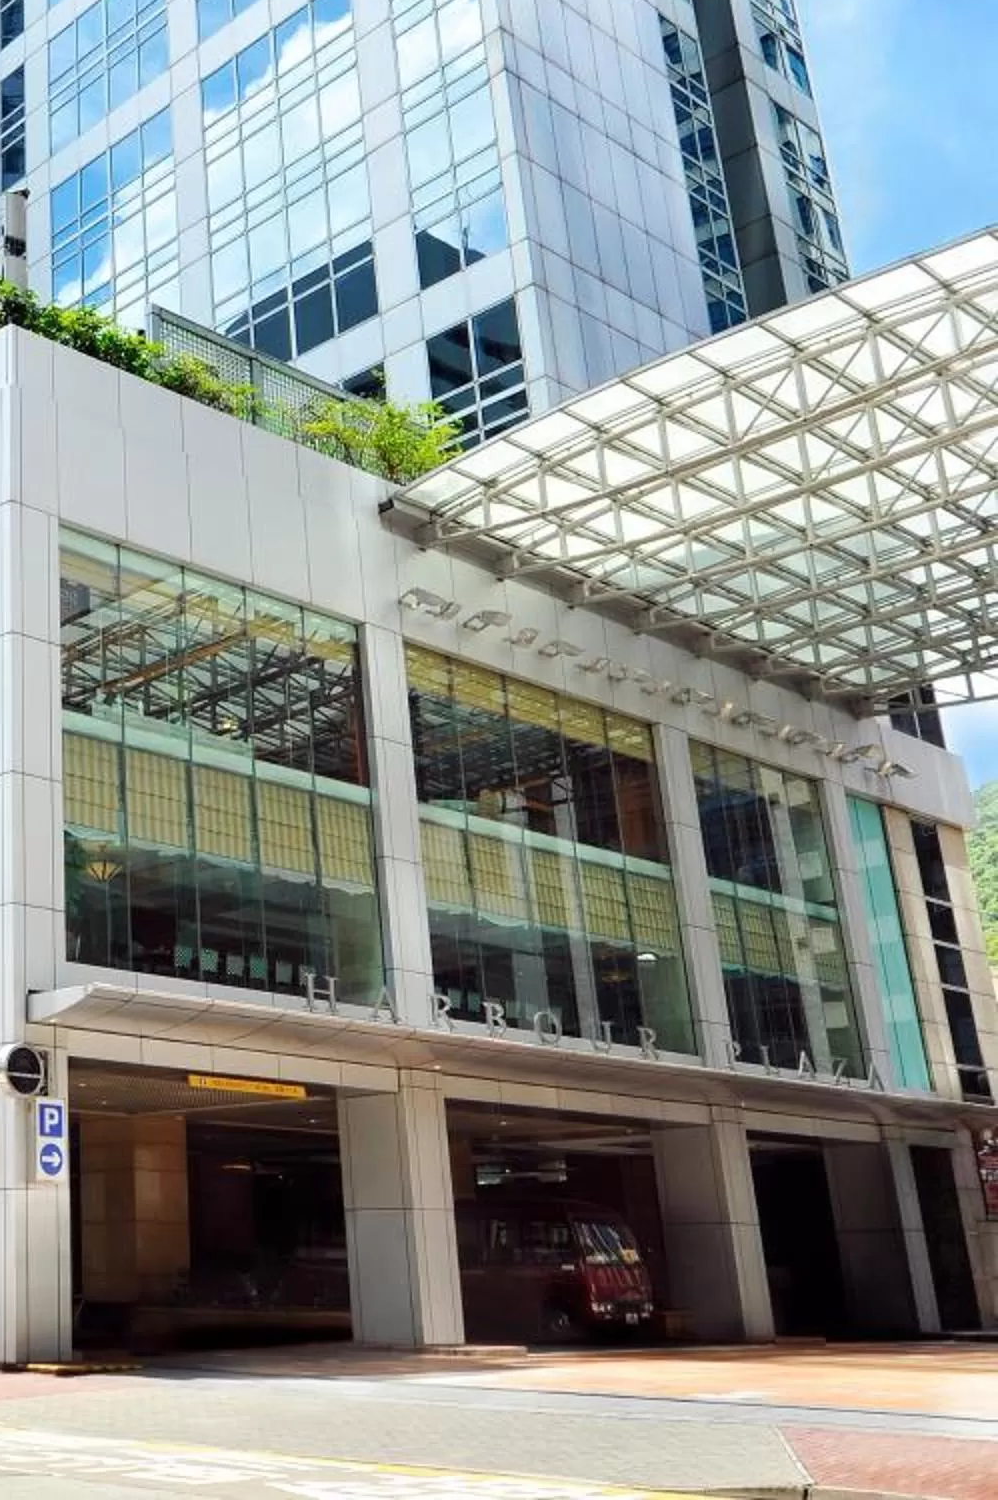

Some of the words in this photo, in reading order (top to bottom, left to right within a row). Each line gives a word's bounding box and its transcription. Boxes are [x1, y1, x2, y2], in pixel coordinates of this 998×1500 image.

[303, 974, 659, 1060] HARBOUR
[724, 1040, 886, 1092] PLAZA
[44, 1107, 58, 1133] P
